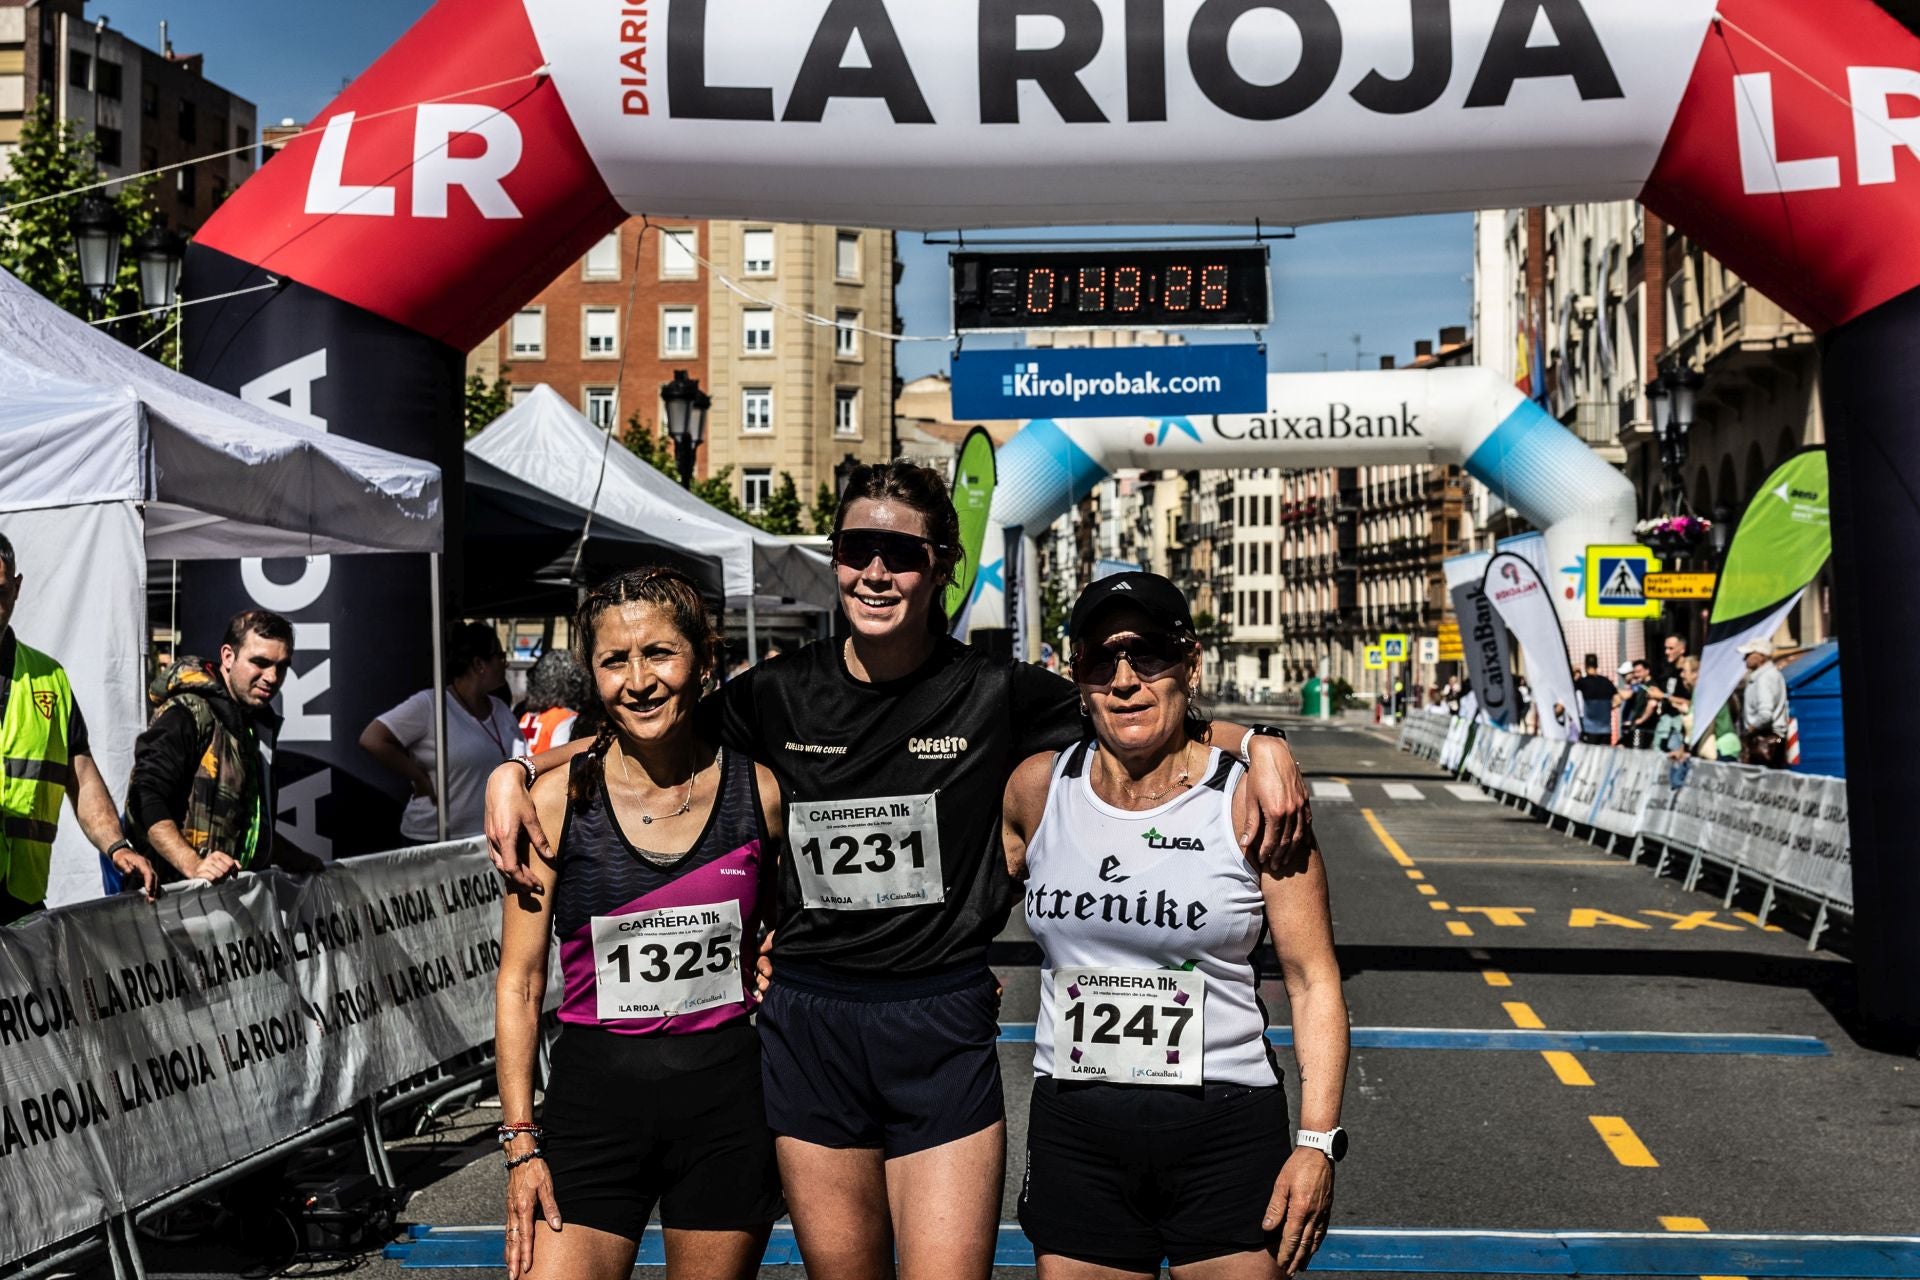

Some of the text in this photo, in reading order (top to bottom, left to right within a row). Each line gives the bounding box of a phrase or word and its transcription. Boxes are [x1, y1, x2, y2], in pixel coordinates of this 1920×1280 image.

[621, 0, 648, 116] DIARI
[667, 0, 1625, 125] LA RIOJA
[1733, 66, 1920, 194] LR
[304, 103, 523, 219] LR
[1014, 371, 1221, 401] Kirolprobak.com
[1212, 402, 1423, 440] CaixaBank
[805, 745, 822, 753] WITH
[823, 746, 848, 754] COFFEE
[809, 806, 888, 822] CARRERA
[801, 831, 925, 875] 1231
[1148, 836, 1205, 851] LUGA
[368, 899, 395, 935] LA
[390, 888, 437, 928] RIOJA
[440, 881, 463, 914] LA
[461, 871, 503, 908] RIOJA
[831, 896, 853, 904] RIOJA
[1027, 884, 1208, 931] etxenike
[618, 914, 699, 932] CARRERA
[1456, 906, 1784, 933] TAXI
[198, 945, 231, 988] LA
[226, 931, 288, 980] RIOJA
[388, 970, 413, 1007] LA
[408, 955, 456, 998] RIOJA
[459, 946, 482, 980] LA
[478, 938, 500, 973] RIO
[607, 934, 732, 983] 1325
[1077, 974, 1155, 989] CARRERA
[89, 971, 127, 1020] LA
[121, 957, 191, 1010] RIOJA
[634, 1004, 660, 1012] RIOJA
[0, 984, 79, 1045] RIOJA
[1065, 1001, 1194, 1047] 1247
[221, 1028, 255, 1072] LA
[248, 1010, 308, 1062] RIOJA
[114, 1063, 153, 1112] LA
[146, 1043, 216, 1100] RIOJA
[1083, 1066, 1107, 1075] RIOJA
[1146, 1069, 1179, 1078] CaixaBank
[21, 1080, 109, 1145] RIOJA
